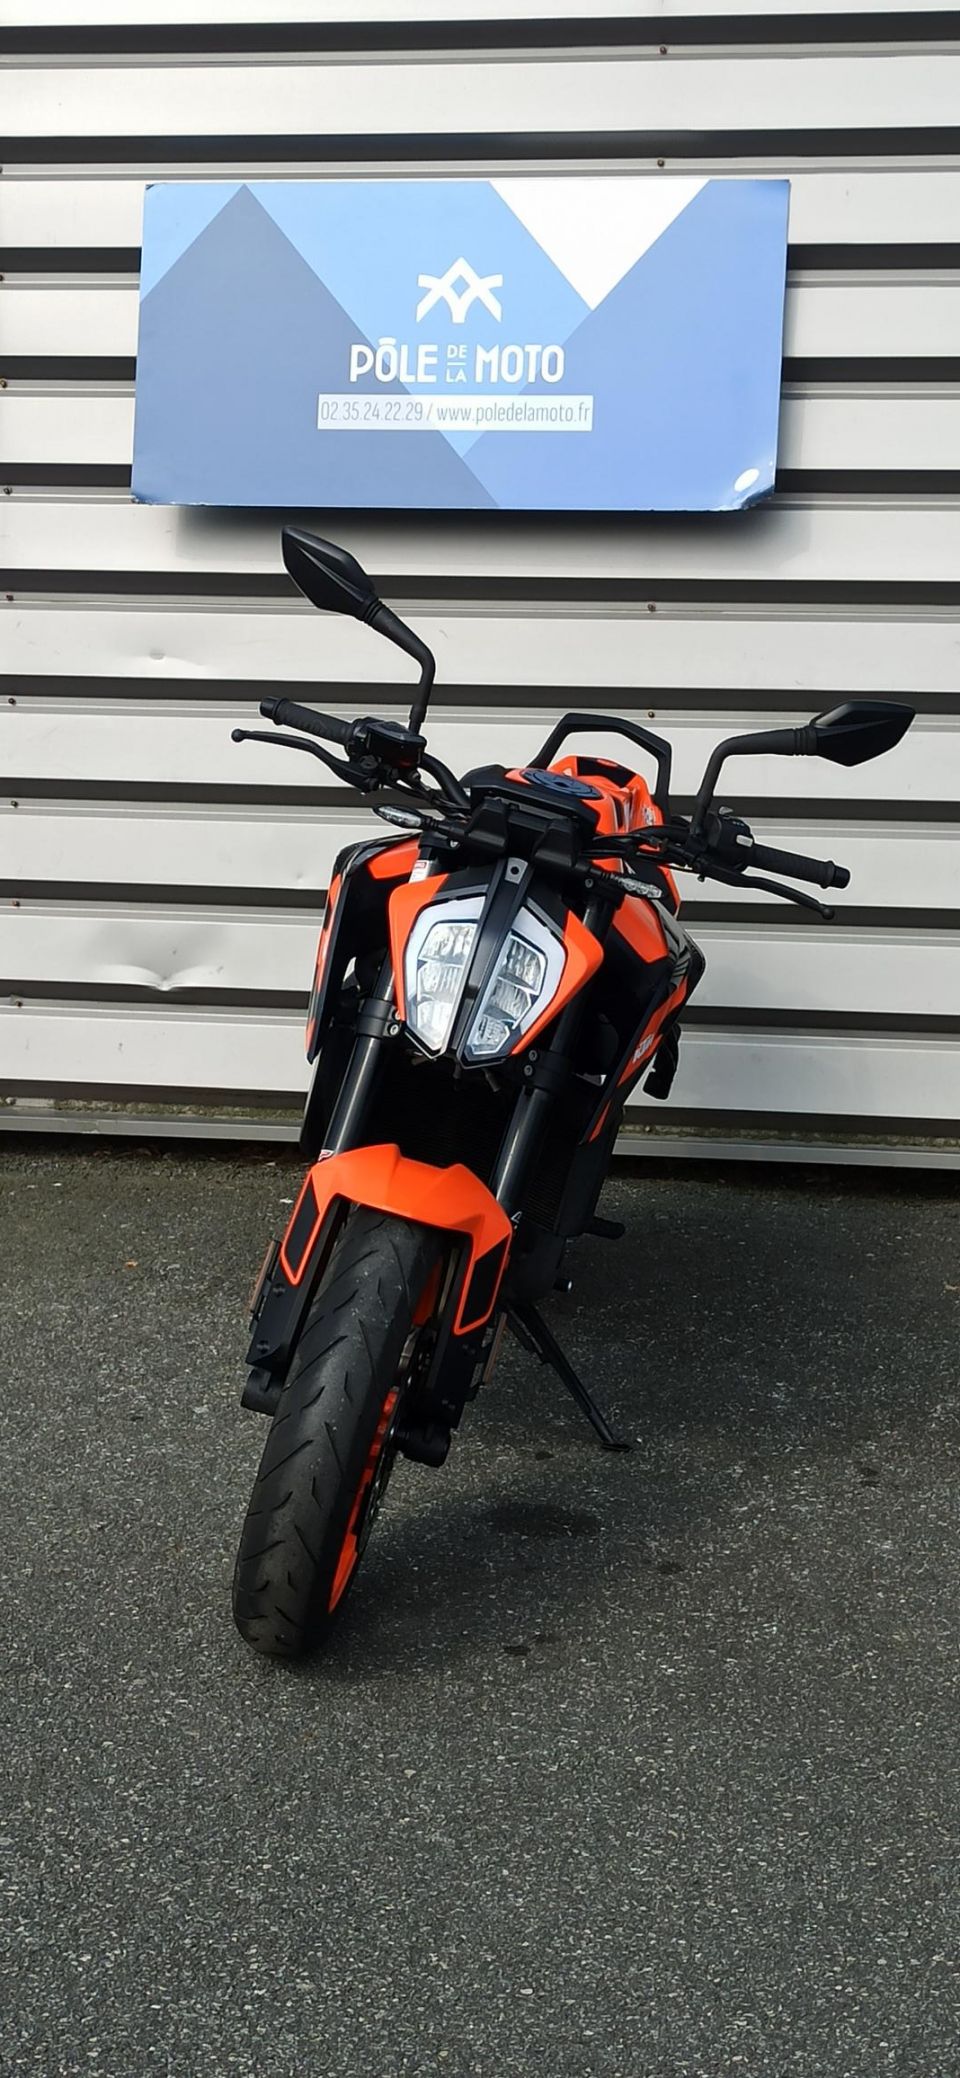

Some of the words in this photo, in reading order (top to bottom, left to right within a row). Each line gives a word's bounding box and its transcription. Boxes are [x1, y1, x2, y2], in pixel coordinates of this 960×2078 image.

[350, 337, 438, 383] PÔLE
[447, 345, 467, 358] DE
[475, 344, 565, 383] MOTO
[446, 368, 467, 383] LA
[320, 401, 423, 421] 02.35.24.22.29
[436, 401, 591, 425] www.poledelamoto.fr
